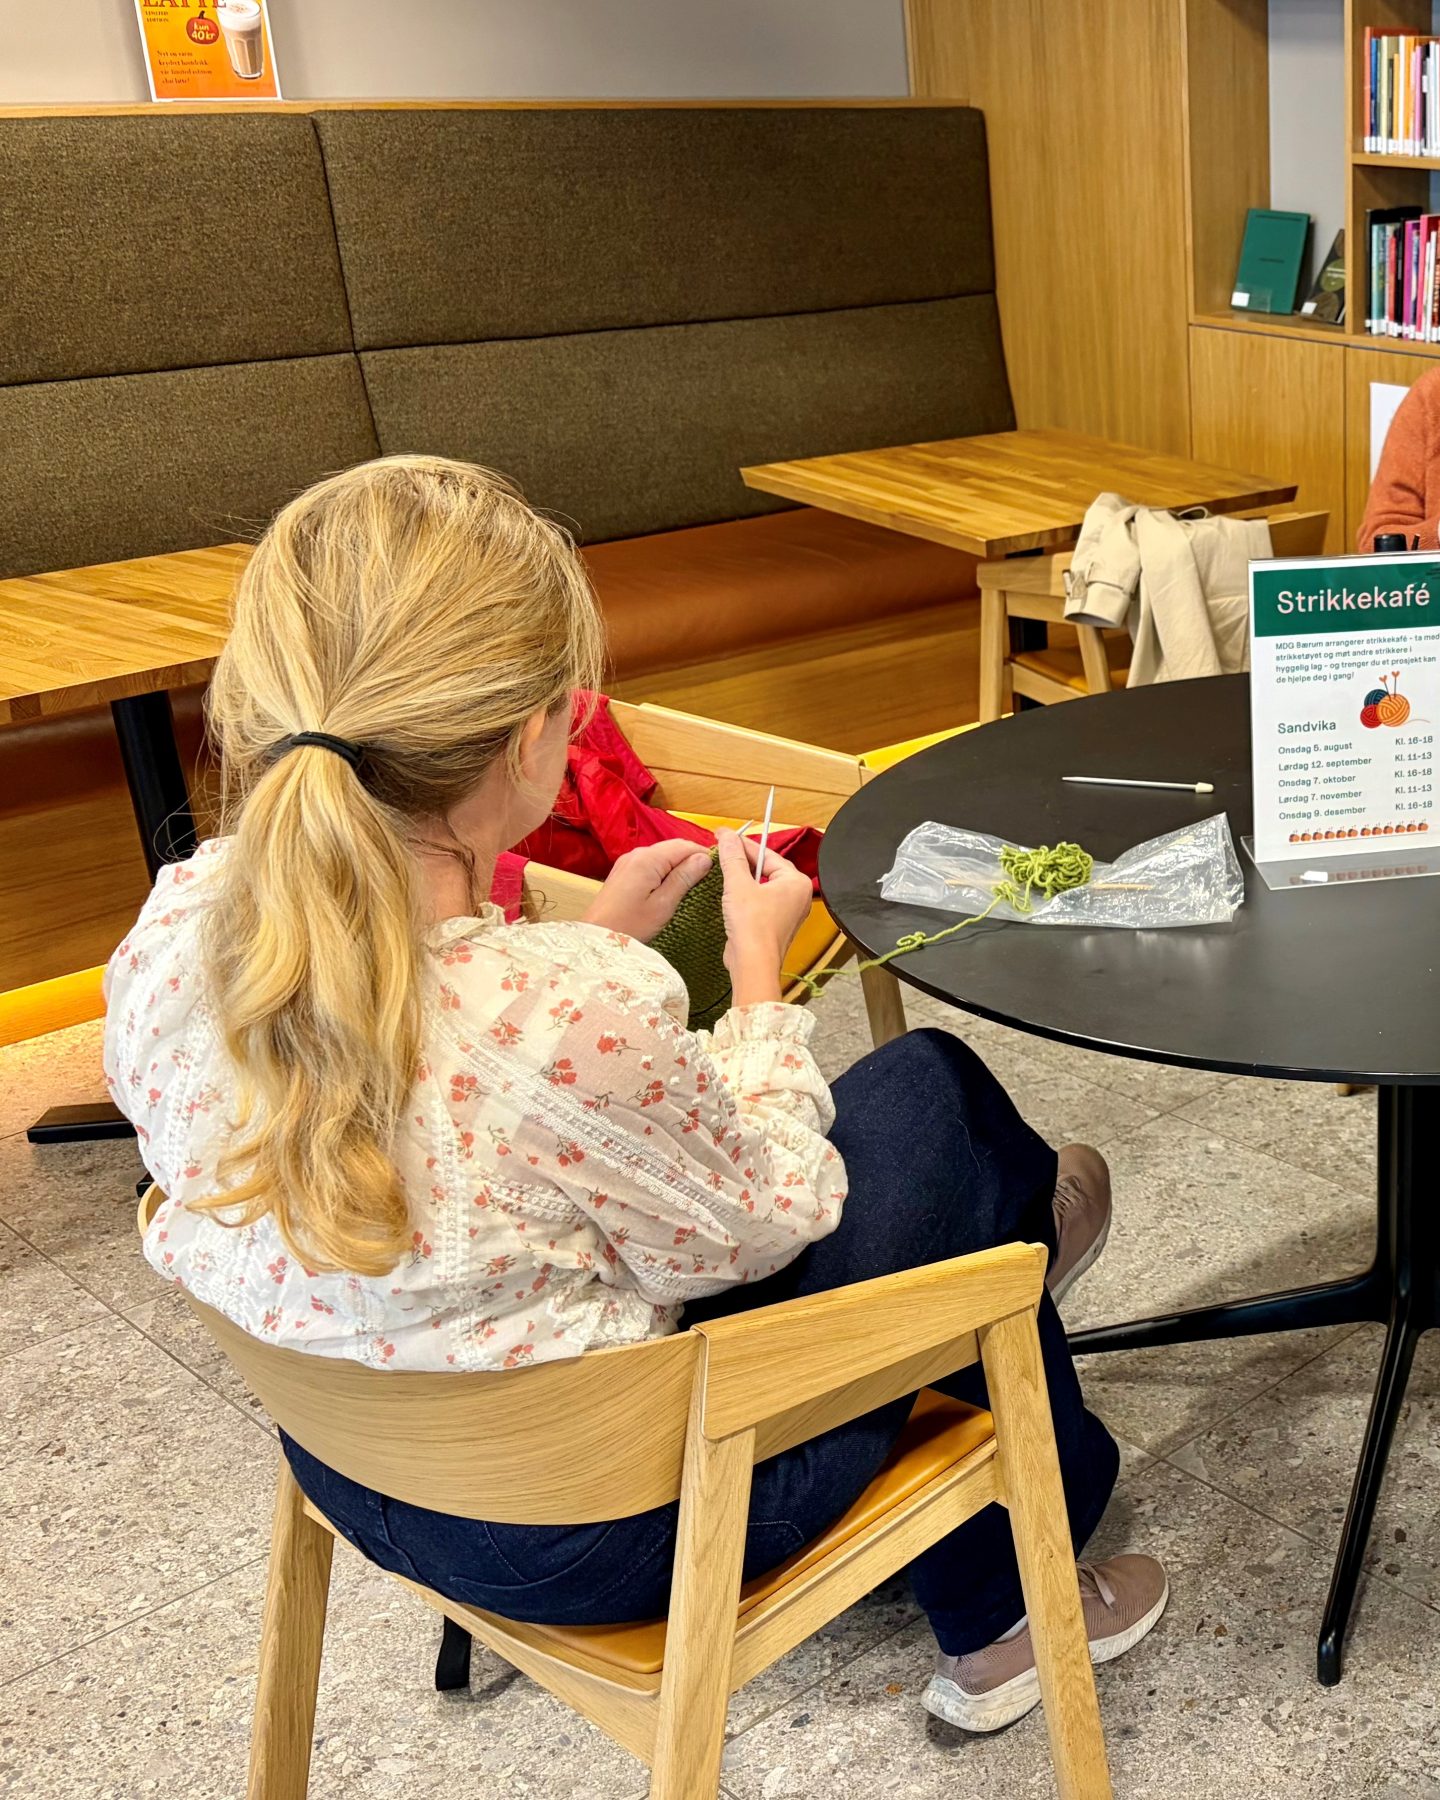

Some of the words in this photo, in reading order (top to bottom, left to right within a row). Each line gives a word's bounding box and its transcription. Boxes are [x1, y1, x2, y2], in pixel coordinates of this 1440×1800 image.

[193, 22, 209, 31] kun
[191, 30, 205, 40] 40
[205, 32, 217, 40] kr
[1277, 582, 1430, 614] Strikkekafé
[1325, 639, 1364, 648] arrangerer
[1366, 635, 1407, 644] strikkekafé
[1424, 633, 1440, 641] med
[1276, 652, 1322, 661] strikketøyet
[1335, 650, 1350, 658] møt
[1352, 648, 1373, 656] andre
[1375, 647, 1408, 655] strikkere
[1276, 663, 1309, 673] hyggelig
[1311, 662, 1322, 671] lag
[1341, 661, 1369, 669] trenger
[1391, 657, 1421, 667] prosjekt
[1288, 674, 1311, 684] hjelpe
[1313, 674, 1327, 682] deg
[1333, 672, 1354, 681] gang!
[1278, 720, 1337, 734] Sandvika
[1324, 742, 1352, 752] august
[1408, 736, 1433, 744] 16-18
[1279, 763, 1309, 771] Lørdag
[1326, 757, 1371, 768] september
[1407, 752, 1432, 760] 11-13
[1278, 779, 1311, 787] Onsdag
[1314, 777, 1321, 785] 7.
[1323, 775, 1356, 784] oktober
[1407, 768, 1432, 776] 16-18
[1279, 795, 1309, 804] Lørdag
[1311, 793, 1318, 801] 7.
[1320, 791, 1362, 800] november
[1395, 786, 1405, 794] Kl.
[1408, 785, 1432, 793] 11-13
[1279, 812, 1312, 820] Onsdag
[1324, 807, 1366, 816] desember
[1408, 801, 1432, 809] 16-18
